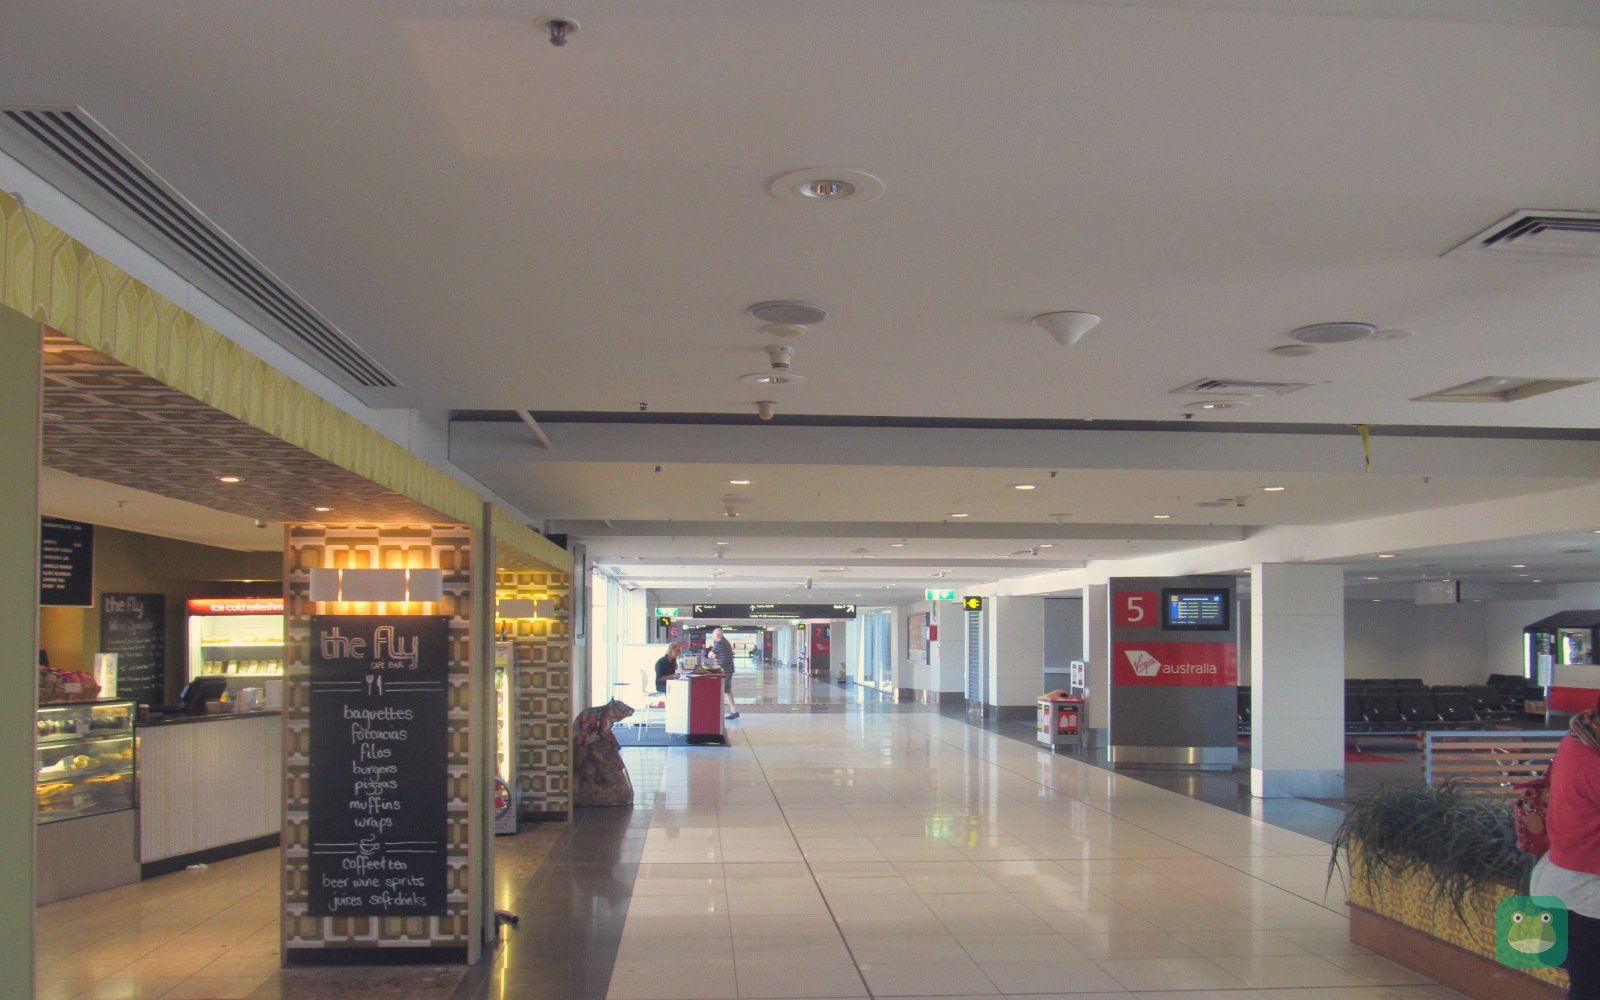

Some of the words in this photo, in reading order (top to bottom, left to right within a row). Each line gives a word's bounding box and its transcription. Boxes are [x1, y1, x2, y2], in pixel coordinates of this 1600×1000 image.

[226, 603, 246, 611] cold
[1126, 596, 1144, 622] 5
[670, 627, 678, 636] 6
[320, 626, 366, 660] the
[373, 625, 418, 670] Fly
[387, 661, 404, 670] BAR
[1162, 663, 1217, 674] australia
[343, 705, 414, 732] baguettes
[360, 743, 392, 762] filos
[352, 760, 398, 782] burgers
[354, 779, 398, 796] pizzas
[349, 796, 401, 814] muffins
[354, 818, 393, 833] wraps
[388, 859, 408, 870] tea
[321, 873, 348, 887] beer
[352, 876, 381, 887] wine
[384, 875, 425, 891] spirits
[328, 891, 363, 911] juices
[394, 891, 427, 907] drinks
